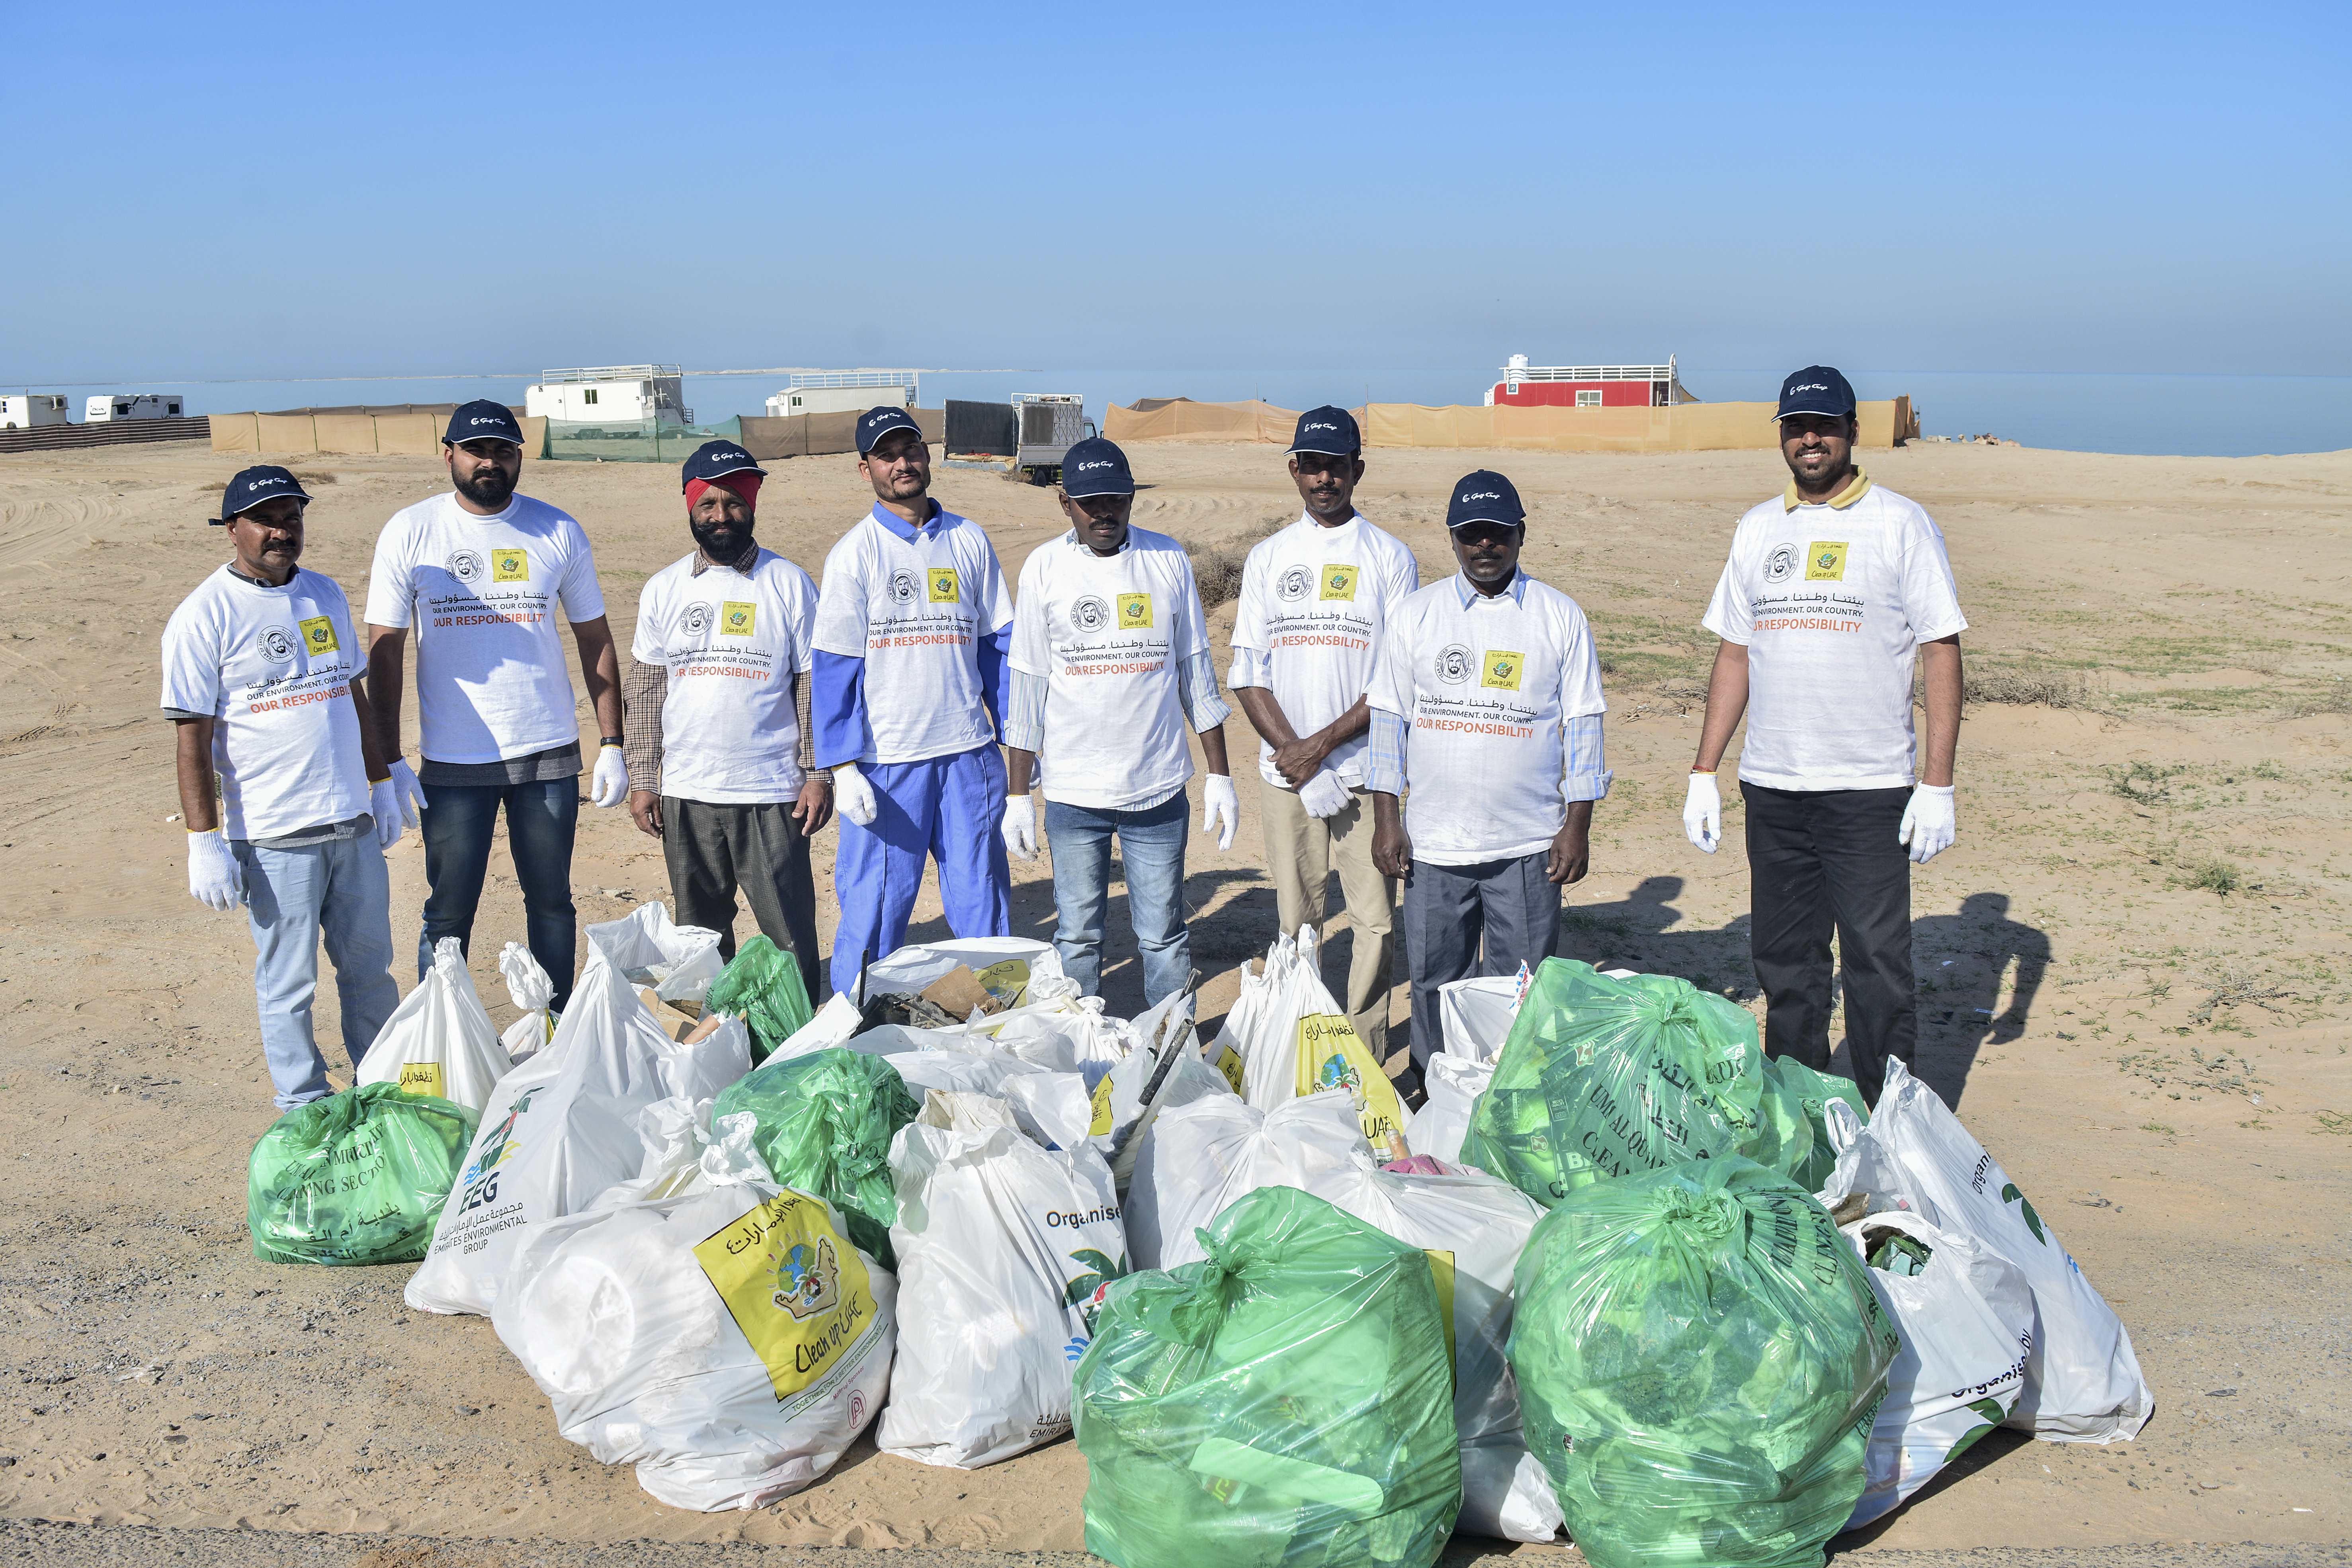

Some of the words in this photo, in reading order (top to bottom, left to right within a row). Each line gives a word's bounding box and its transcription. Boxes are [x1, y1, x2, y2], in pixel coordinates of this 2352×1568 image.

[443, 604, 498, 613] ENVIRONMENT.
[1825, 607, 1864, 617] COUNTRY.
[434, 617, 453, 627] OUR
[456, 613, 546, 626] RESPONSIBILITY
[1764, 618, 1862, 633] RESPONSIBILITY
[883, 625, 934, 635] ENVIRONMENT.
[1337, 624, 1372, 637] COUNTRY.
[869, 638, 891, 649] OUR
[894, 634, 972, 647] RESPONSIBILITY
[1109, 639, 1143, 649] وطننا.
[738, 658, 772, 668] COUNTRY.
[1071, 653, 1123, 663] ENVIRONMENT.
[1065, 666, 1082, 676] OUR
[1082, 660, 1165, 675] RESPONSIBILITY
[246, 673, 303, 691] مسؤوليتنا
[247, 691, 265, 701] OUR
[266, 680, 323, 697] ENVIRONMENT.
[324, 675, 338, 684] OUR
[250, 700, 280, 714] OUR
[1428, 708, 1481, 719] ENVIRONMENT.
[1483, 712, 1500, 721] OUR
[1416, 717, 1433, 729] OUR
[1435, 719, 1534, 738] RESPONSIBILITY
[457, 1171, 500, 1217] EEG
[463, 1215, 528, 1243] ENVIRONMENTAL
[463, 1239, 488, 1254] GROUP
[795, 1343, 830, 1373] Clean
[828, 1322, 842, 1347] up
[791, 1389, 825, 1412] TOGETHER
[823, 1379, 835, 1391] FOR
[838, 1359, 856, 1379] BETTER
[833, 1382, 849, 1401] Material
[847, 1365, 865, 1385] Sponsor
